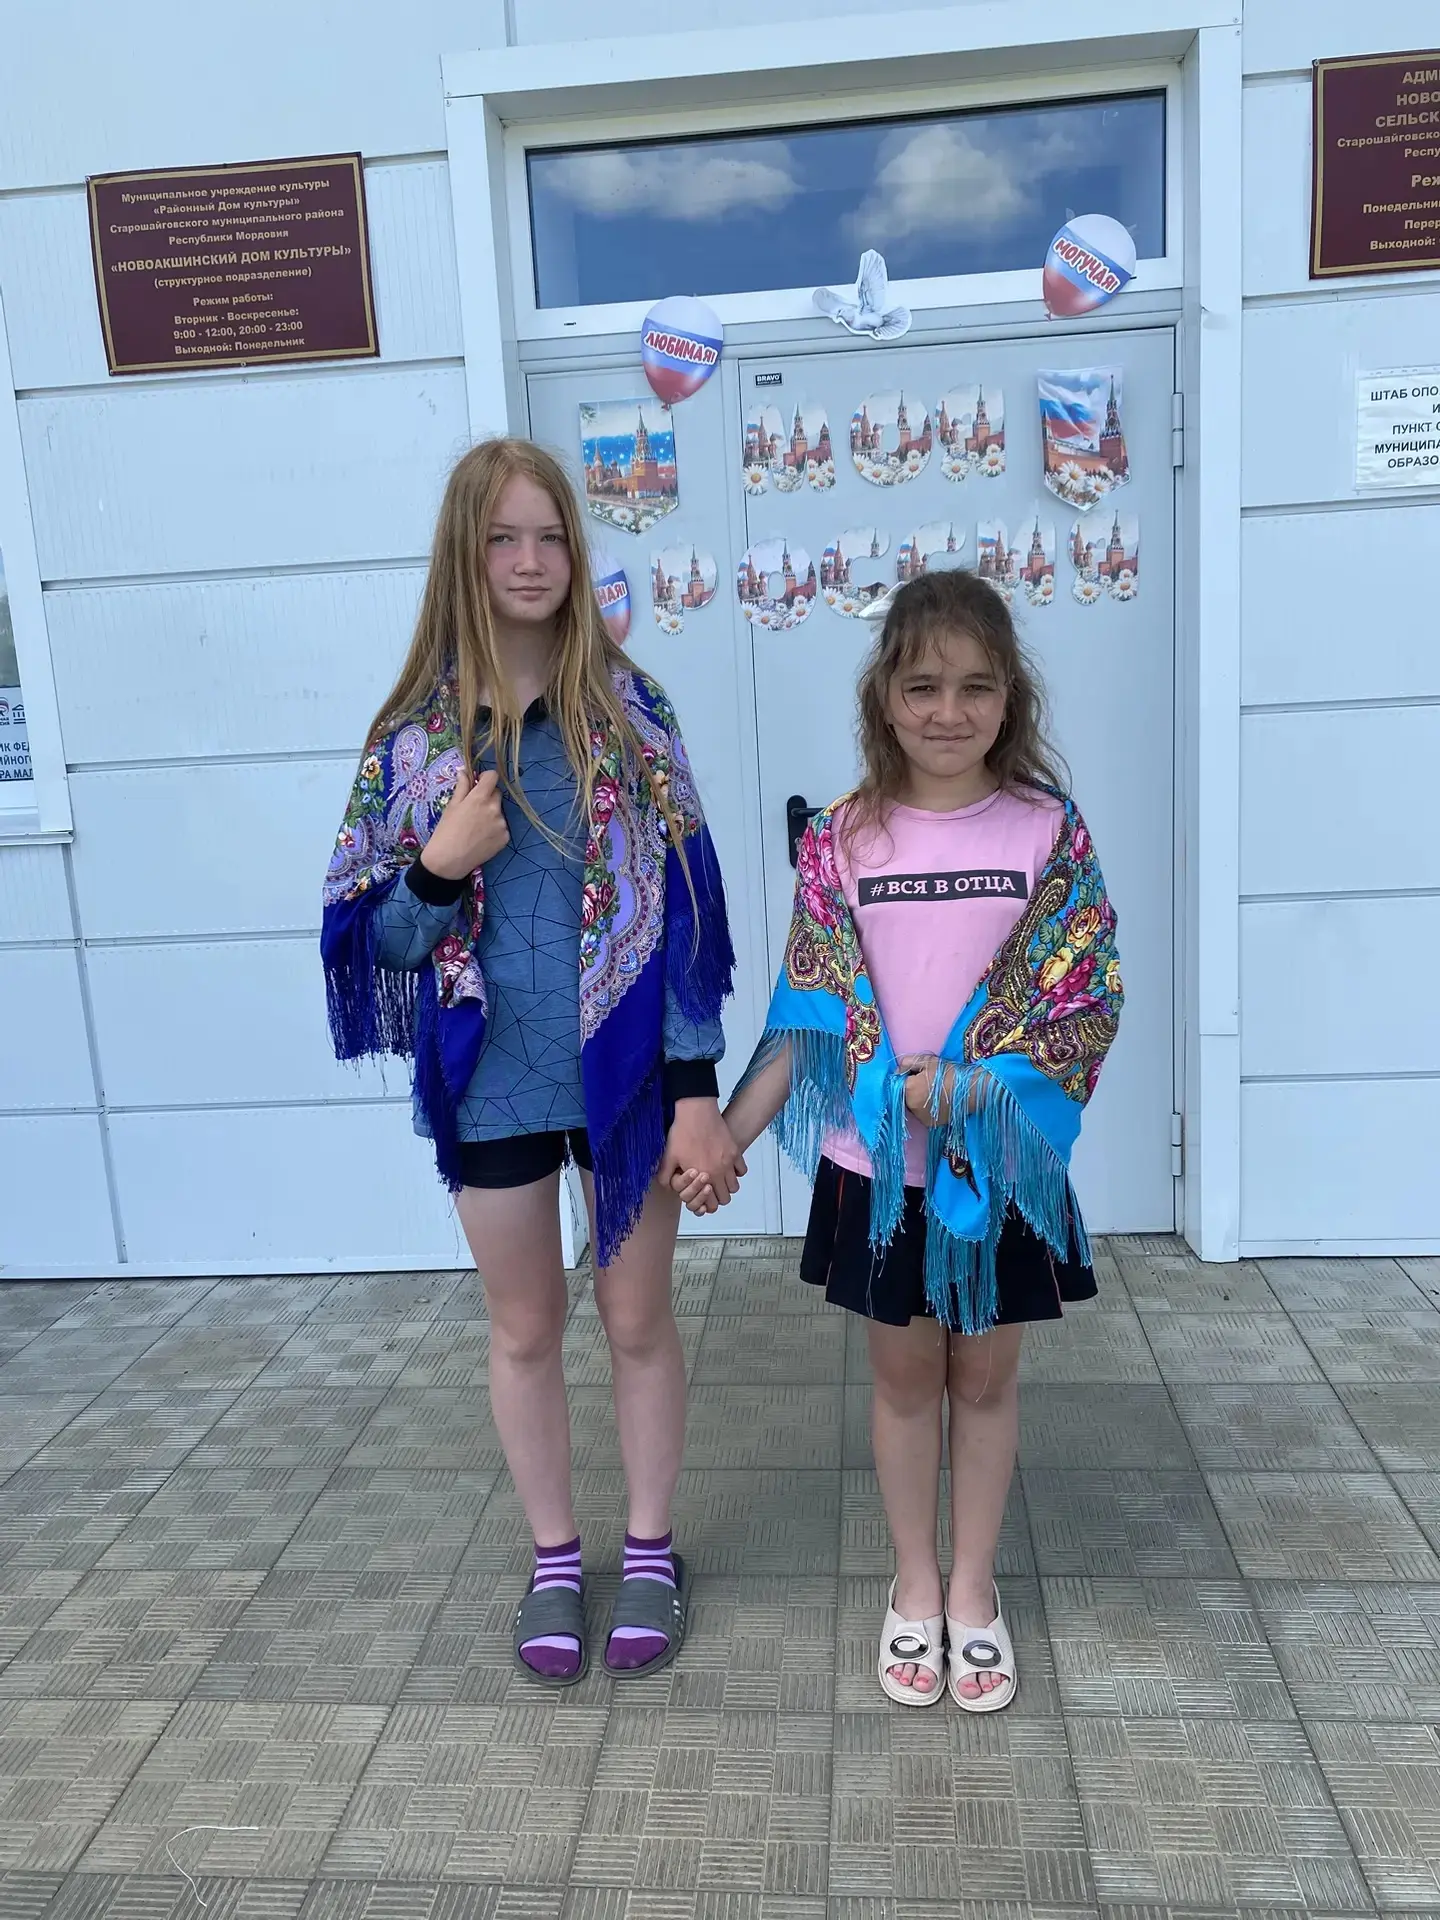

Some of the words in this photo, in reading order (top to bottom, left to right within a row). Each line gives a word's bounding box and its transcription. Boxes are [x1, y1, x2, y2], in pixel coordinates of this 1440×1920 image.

[1402, 69, 1440, 84] АДМ
[1396, 91, 1440, 106] НОВО
[1376, 111, 1440, 128] СЕЛЬСК
[1337, 131, 1440, 147] Старошайговско
[1404, 147, 1440, 158] Респу
[122, 190, 208, 204] Муниципальное
[210, 184, 276, 198] учреждение
[280, 180, 330, 192] культуры
[154, 202, 215, 214] «Районный
[218, 201, 240, 212] Дом
[244, 198, 300, 210] культуры»
[1363, 200, 1440, 214] Понедельни
[110, 220, 208, 234] Старошайговского
[212, 213, 302, 227] муниципального
[305, 209, 344, 221] района
[1404, 220, 1440, 230] Перер
[169, 234, 232, 245] Республики
[236, 230, 288, 240] Мордовия
[1370, 236, 1436, 250] Выходной:
[111, 252, 237, 272] «НОВОАКШИНСКИЙ
[241, 251, 270, 264] ДОМ
[274, 245, 352, 260] КУЛЬТУРЫ»
[1054, 238, 1119, 292] МОГУЧАЯ!
[154, 274, 222, 288] (структурное
[226, 267, 312, 282] подразделение)
[193, 296, 230, 306] Режим
[232, 293, 274, 305] работы:
[174, 314, 218, 326] Вторник
[228, 308, 299, 321] Воскресенье:
[174, 330, 196, 340] 9:00
[205, 327, 236, 338] 12:00,
[239, 324, 266, 335] 20:00
[276, 321, 303, 332] 23:00
[175, 343, 232, 355] Выходной:
[235, 337, 305, 350] Понедельник
[645, 332, 718, 365] ЛЮБИМАЯ!
[1370, 388, 1408, 401] ШТАБ
[1412, 386, 1440, 398] ОПО
[1392, 422, 1432, 434] ПУНКТ
[1388, 455, 1440, 468] ОБРАЗО
[870, 880, 928, 896] #ВСЯ
[934, 880, 949, 894] В
[954, 876, 1016, 892] ОТЦА
